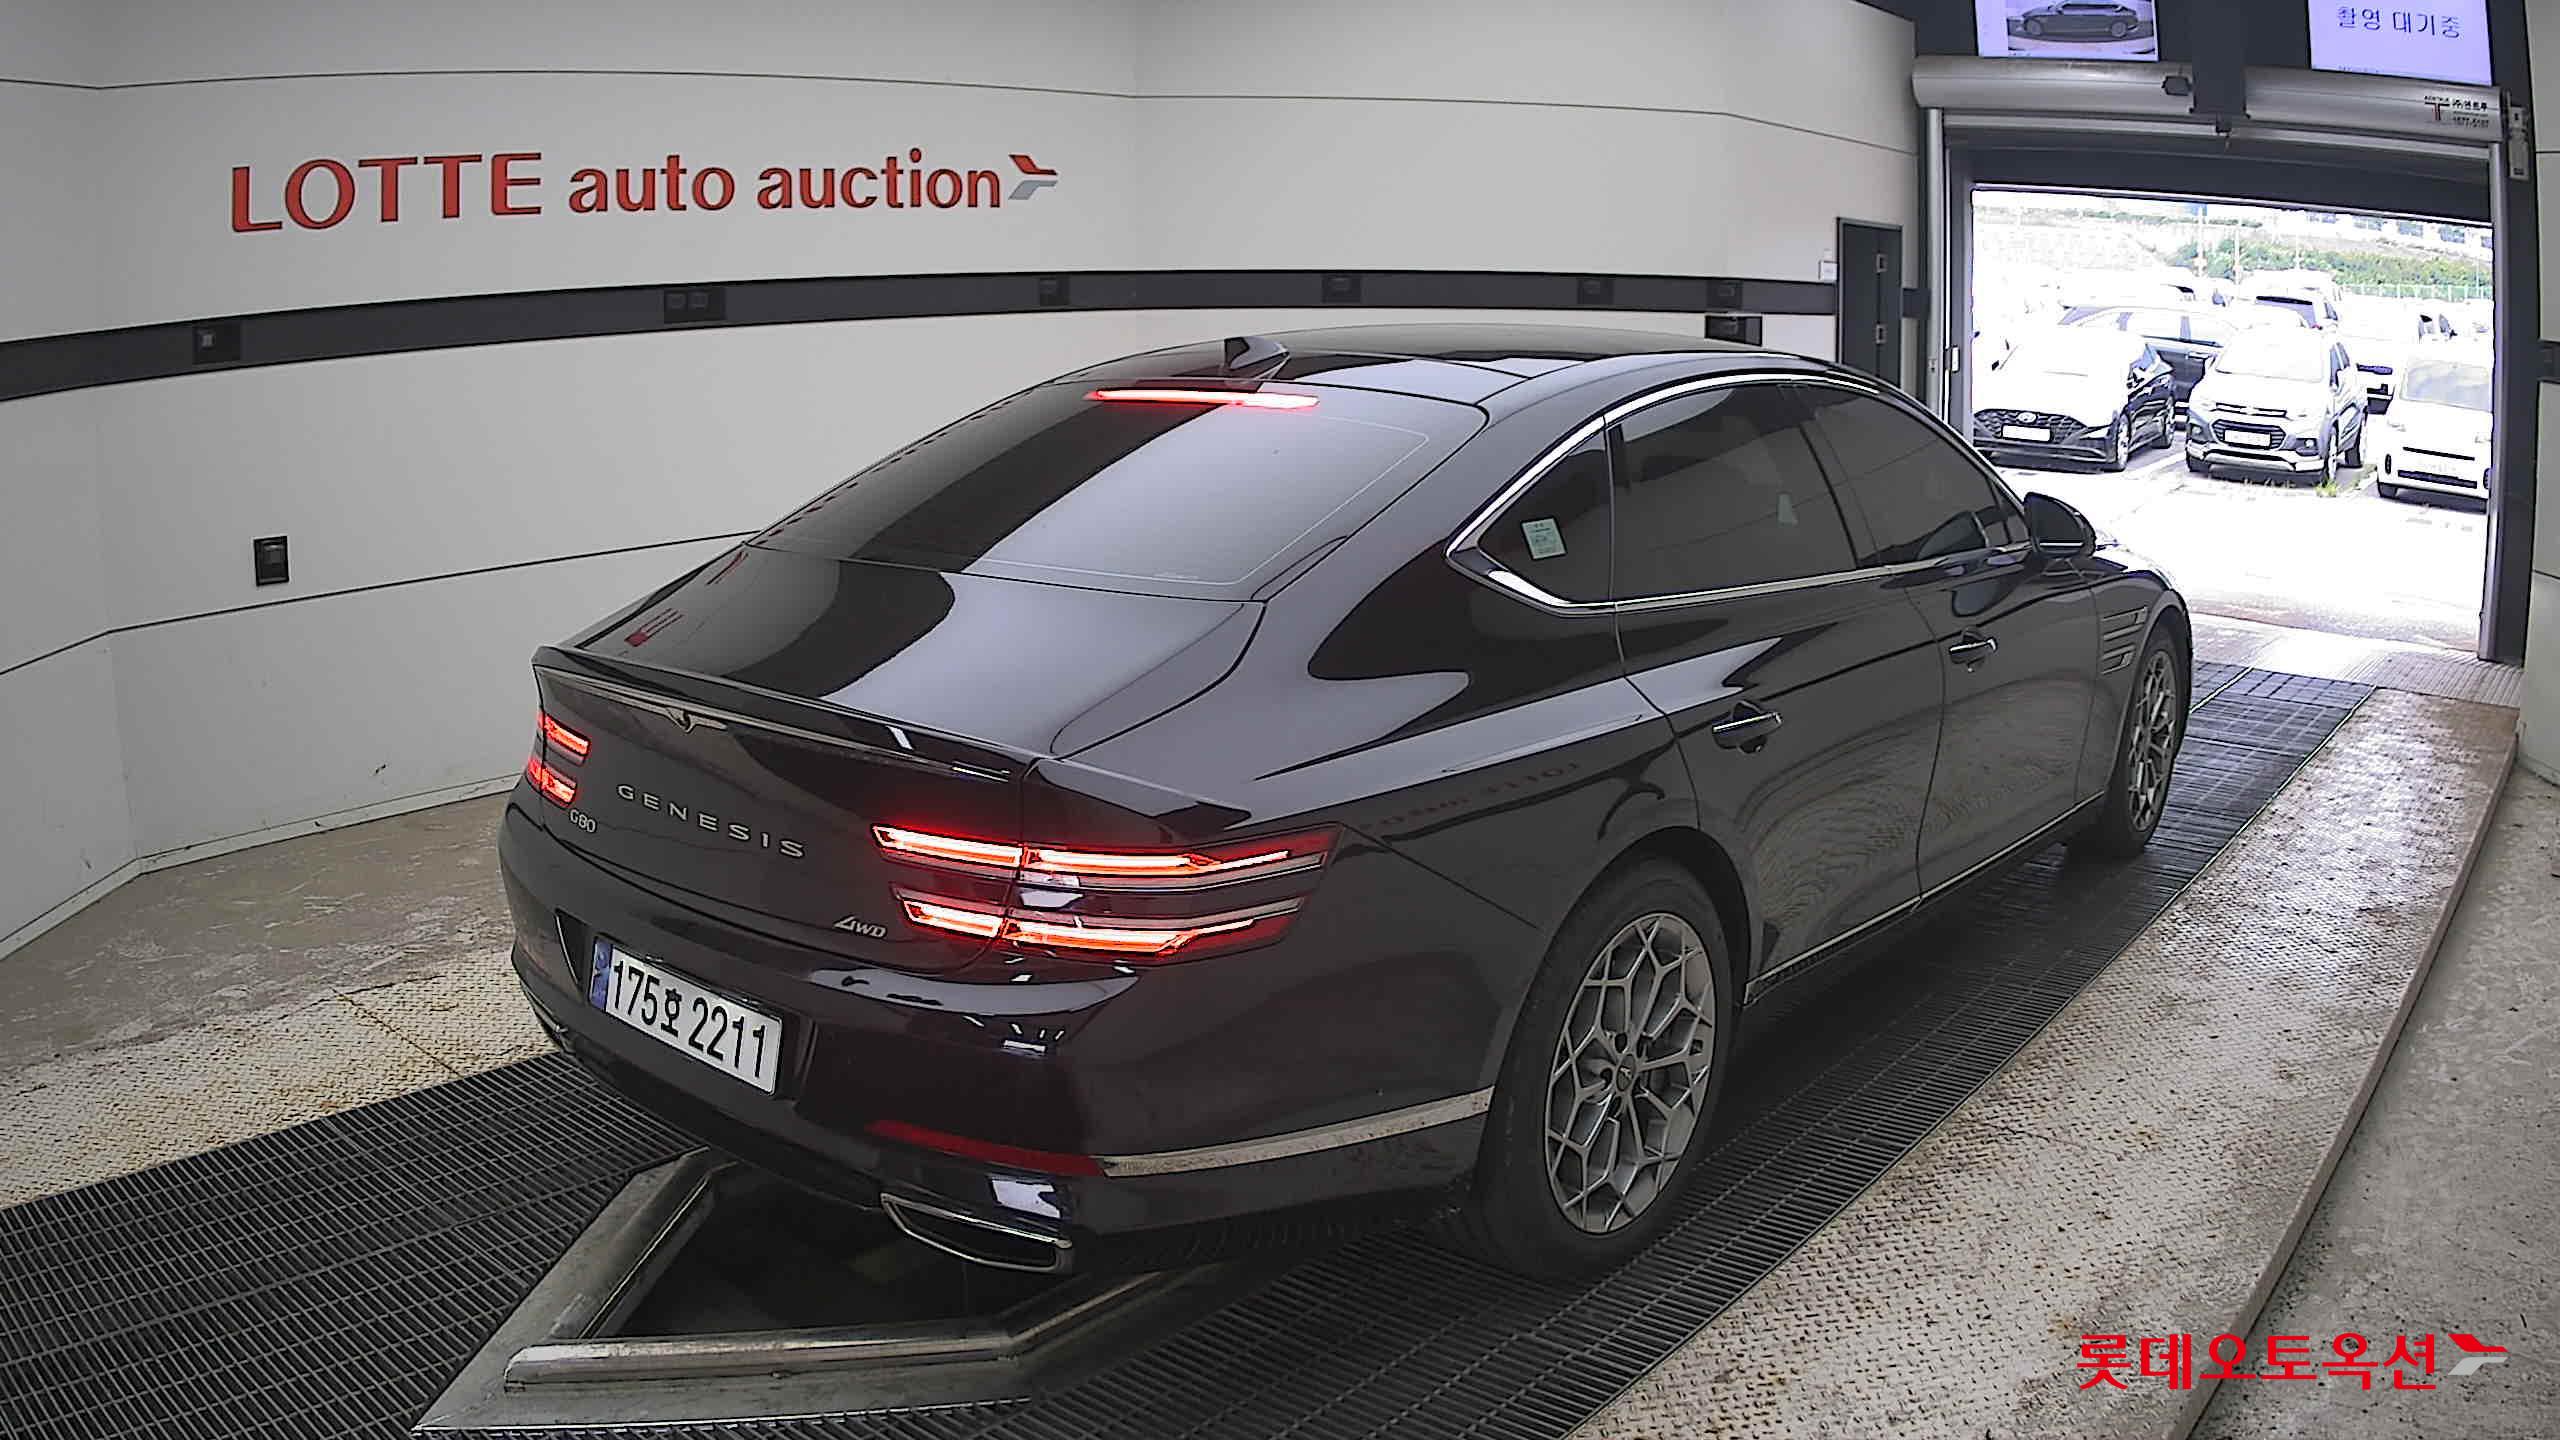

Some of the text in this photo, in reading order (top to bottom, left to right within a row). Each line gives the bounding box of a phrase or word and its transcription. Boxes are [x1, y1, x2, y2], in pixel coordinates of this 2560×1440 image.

[2337, 6, 2462, 39] 촬영 대기중
[232, 148, 1002, 233] LOTTE auto auction
[568, 808, 597, 833] G80
[617, 784, 804, 858] GENESIS
[688, 996, 766, 1079] 2211
